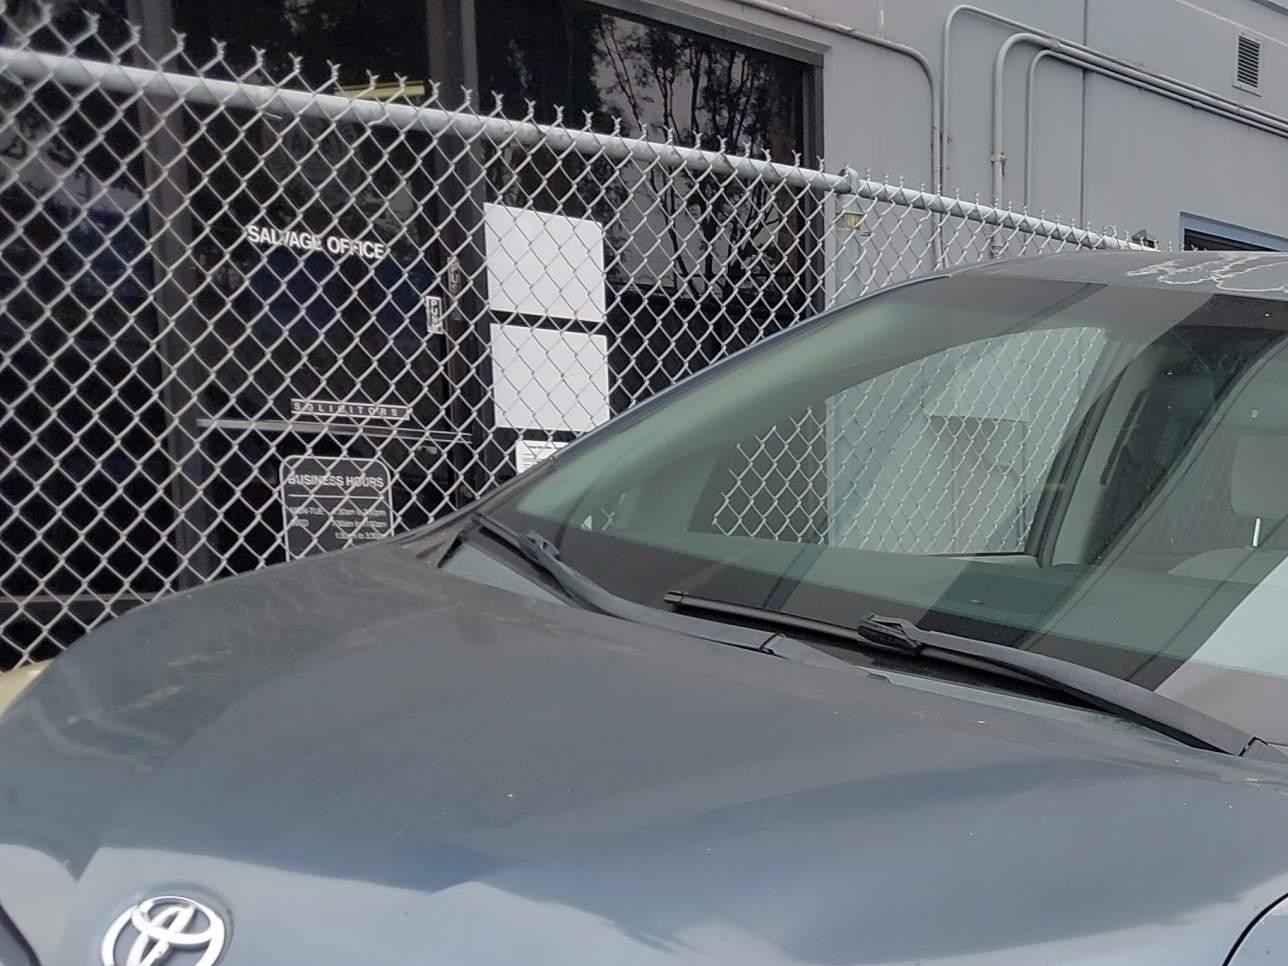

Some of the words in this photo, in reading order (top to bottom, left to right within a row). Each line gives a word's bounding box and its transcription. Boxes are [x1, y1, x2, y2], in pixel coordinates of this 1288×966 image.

[247, 226, 322, 251] SALVAGE
[326, 235, 385, 260] OFFICE
[287, 474, 344, 487] BUSINESS
[345, 475, 385, 488] HOURS
